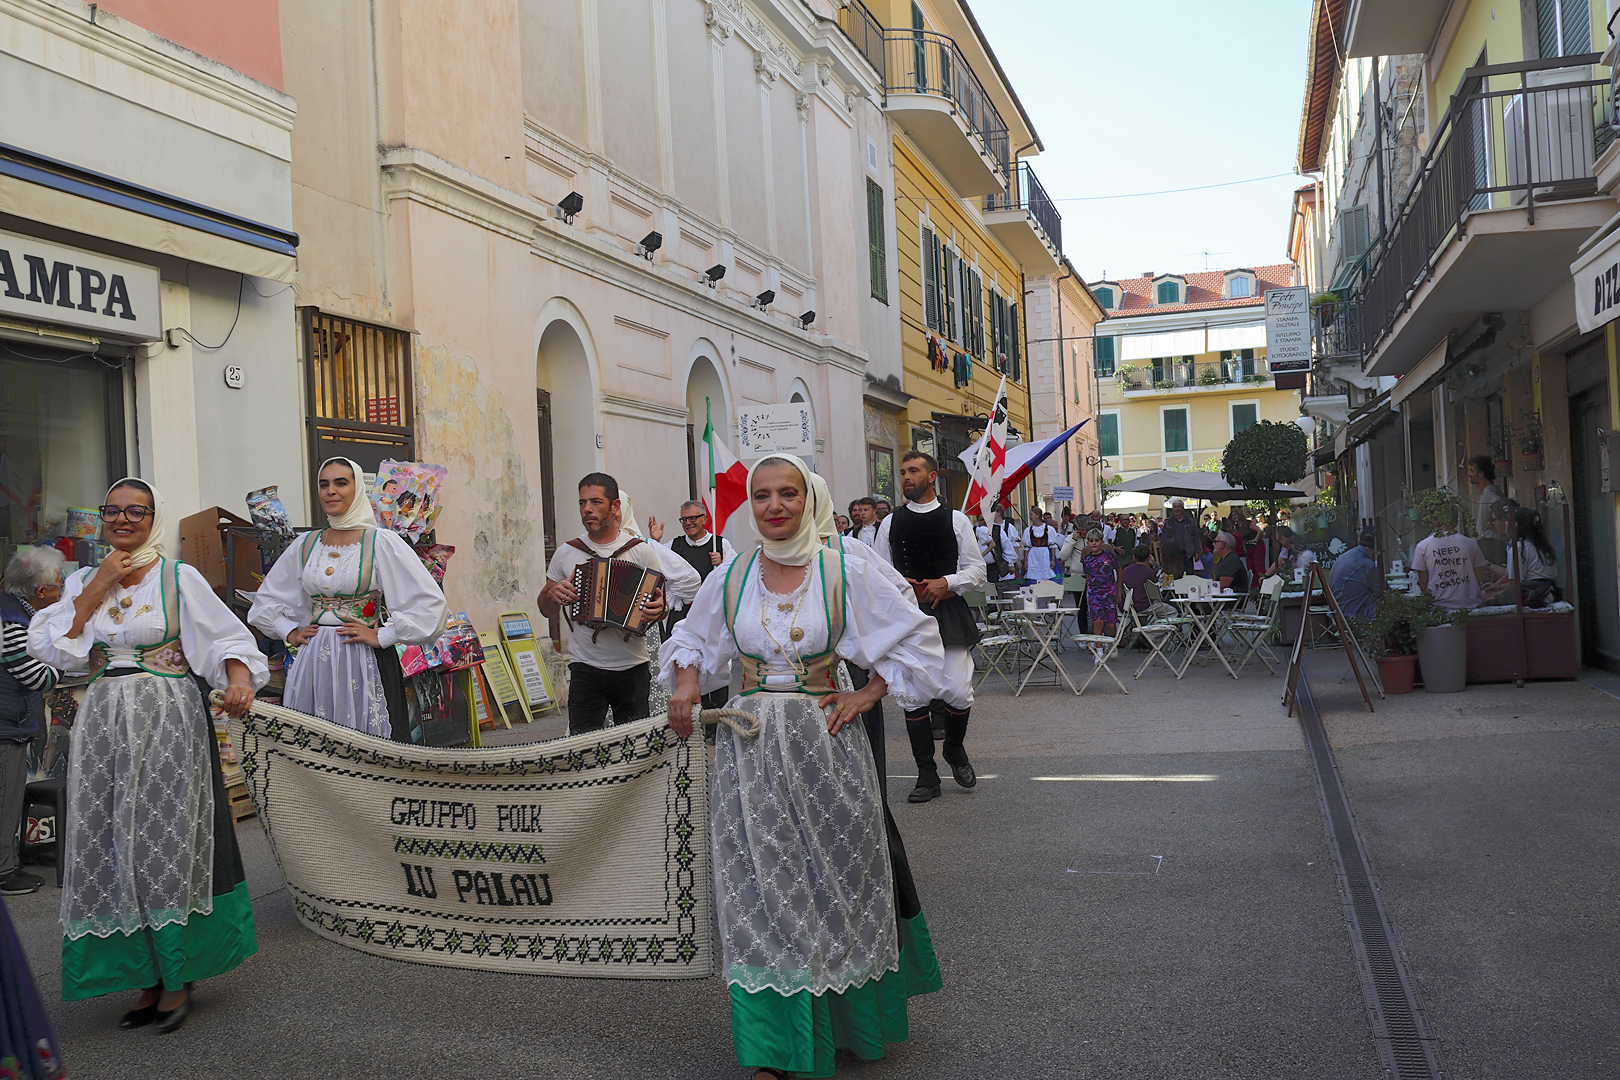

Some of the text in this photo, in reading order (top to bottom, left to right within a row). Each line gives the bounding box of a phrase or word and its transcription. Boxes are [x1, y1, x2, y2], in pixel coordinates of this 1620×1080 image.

[0, 249, 137, 321] AMPA
[1594, 262, 1620, 316] PIZZ
[1269, 291, 1296, 302] Foto
[1271, 301, 1303, 314] Principe
[1432, 546, 1460, 558] NEED
[1434, 557, 1468, 566] MONEY
[1438, 569, 1458, 580] FOR
[1435, 575, 1471, 591] PORSCHE
[390, 797, 544, 833] GRUPPO FOLK
[400, 862, 554, 906] LU PALAU
